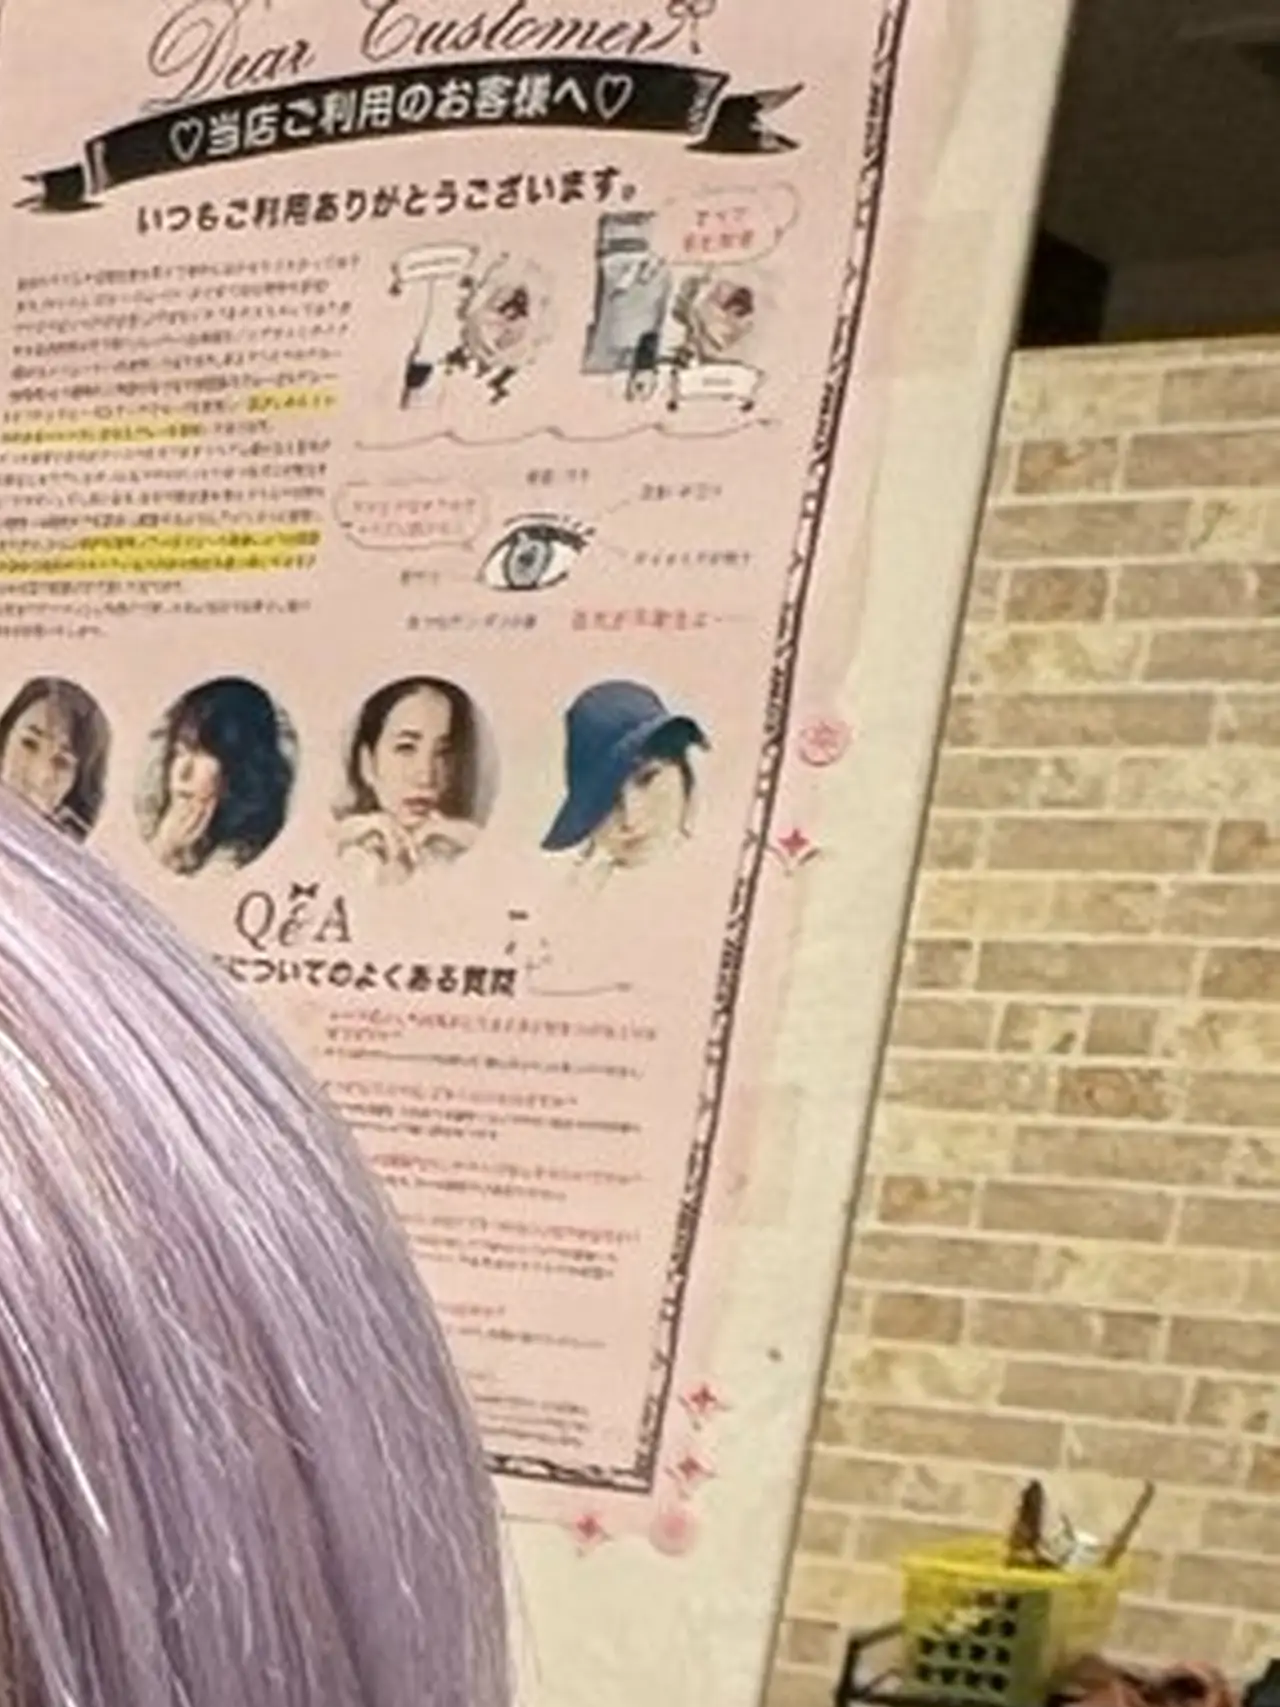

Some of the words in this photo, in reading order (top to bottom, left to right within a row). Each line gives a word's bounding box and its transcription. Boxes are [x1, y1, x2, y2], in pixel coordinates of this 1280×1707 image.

[147, 0, 317, 104] Dear
[358, 0, 680, 62] Customer
[207, 73, 588, 156] 当店ご利用のお客様へ
[137, 166, 639, 236] いつもご利用ありがとうございます。
[233, 889, 352, 951] Q&A
[212, 954, 518, 997] についてのよくある質問
